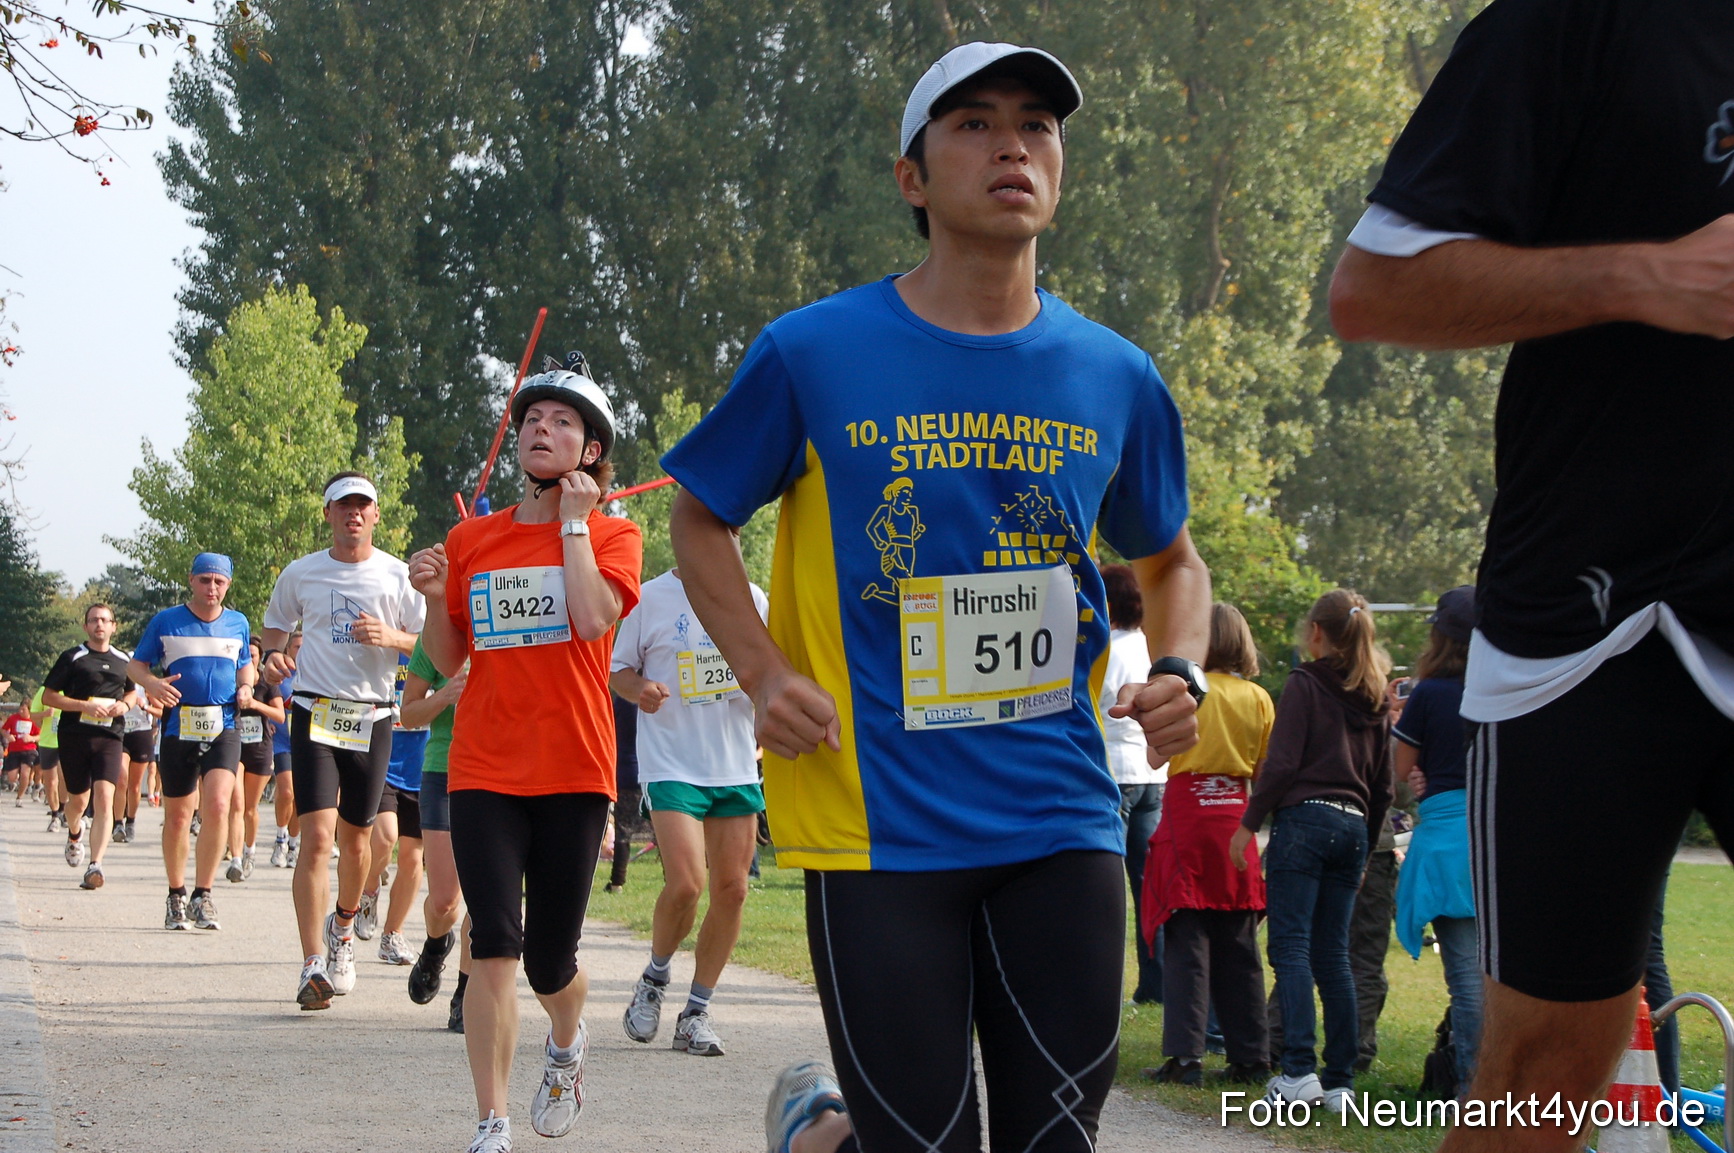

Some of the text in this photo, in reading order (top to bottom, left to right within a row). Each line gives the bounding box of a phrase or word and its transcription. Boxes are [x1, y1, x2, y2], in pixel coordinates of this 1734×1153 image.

[845, 412, 1099, 457] 10. NEUMARKTER
[890, 442, 1065, 475] STADTLAUF
[495, 575, 529, 591] Ulrike
[475, 600, 482, 611] C
[498, 595, 556, 620] 3422
[953, 583, 1037, 616] Hiroshi
[911, 635, 922, 656] C
[974, 628, 1053, 674] 510
[696, 654, 724, 665] Hartm
[705, 667, 734, 685] 236
[330, 702, 355, 715] Marco
[925, 707, 973, 721] BOCK
[195, 720, 216, 730] 967
[333, 718, 362, 734] 594
